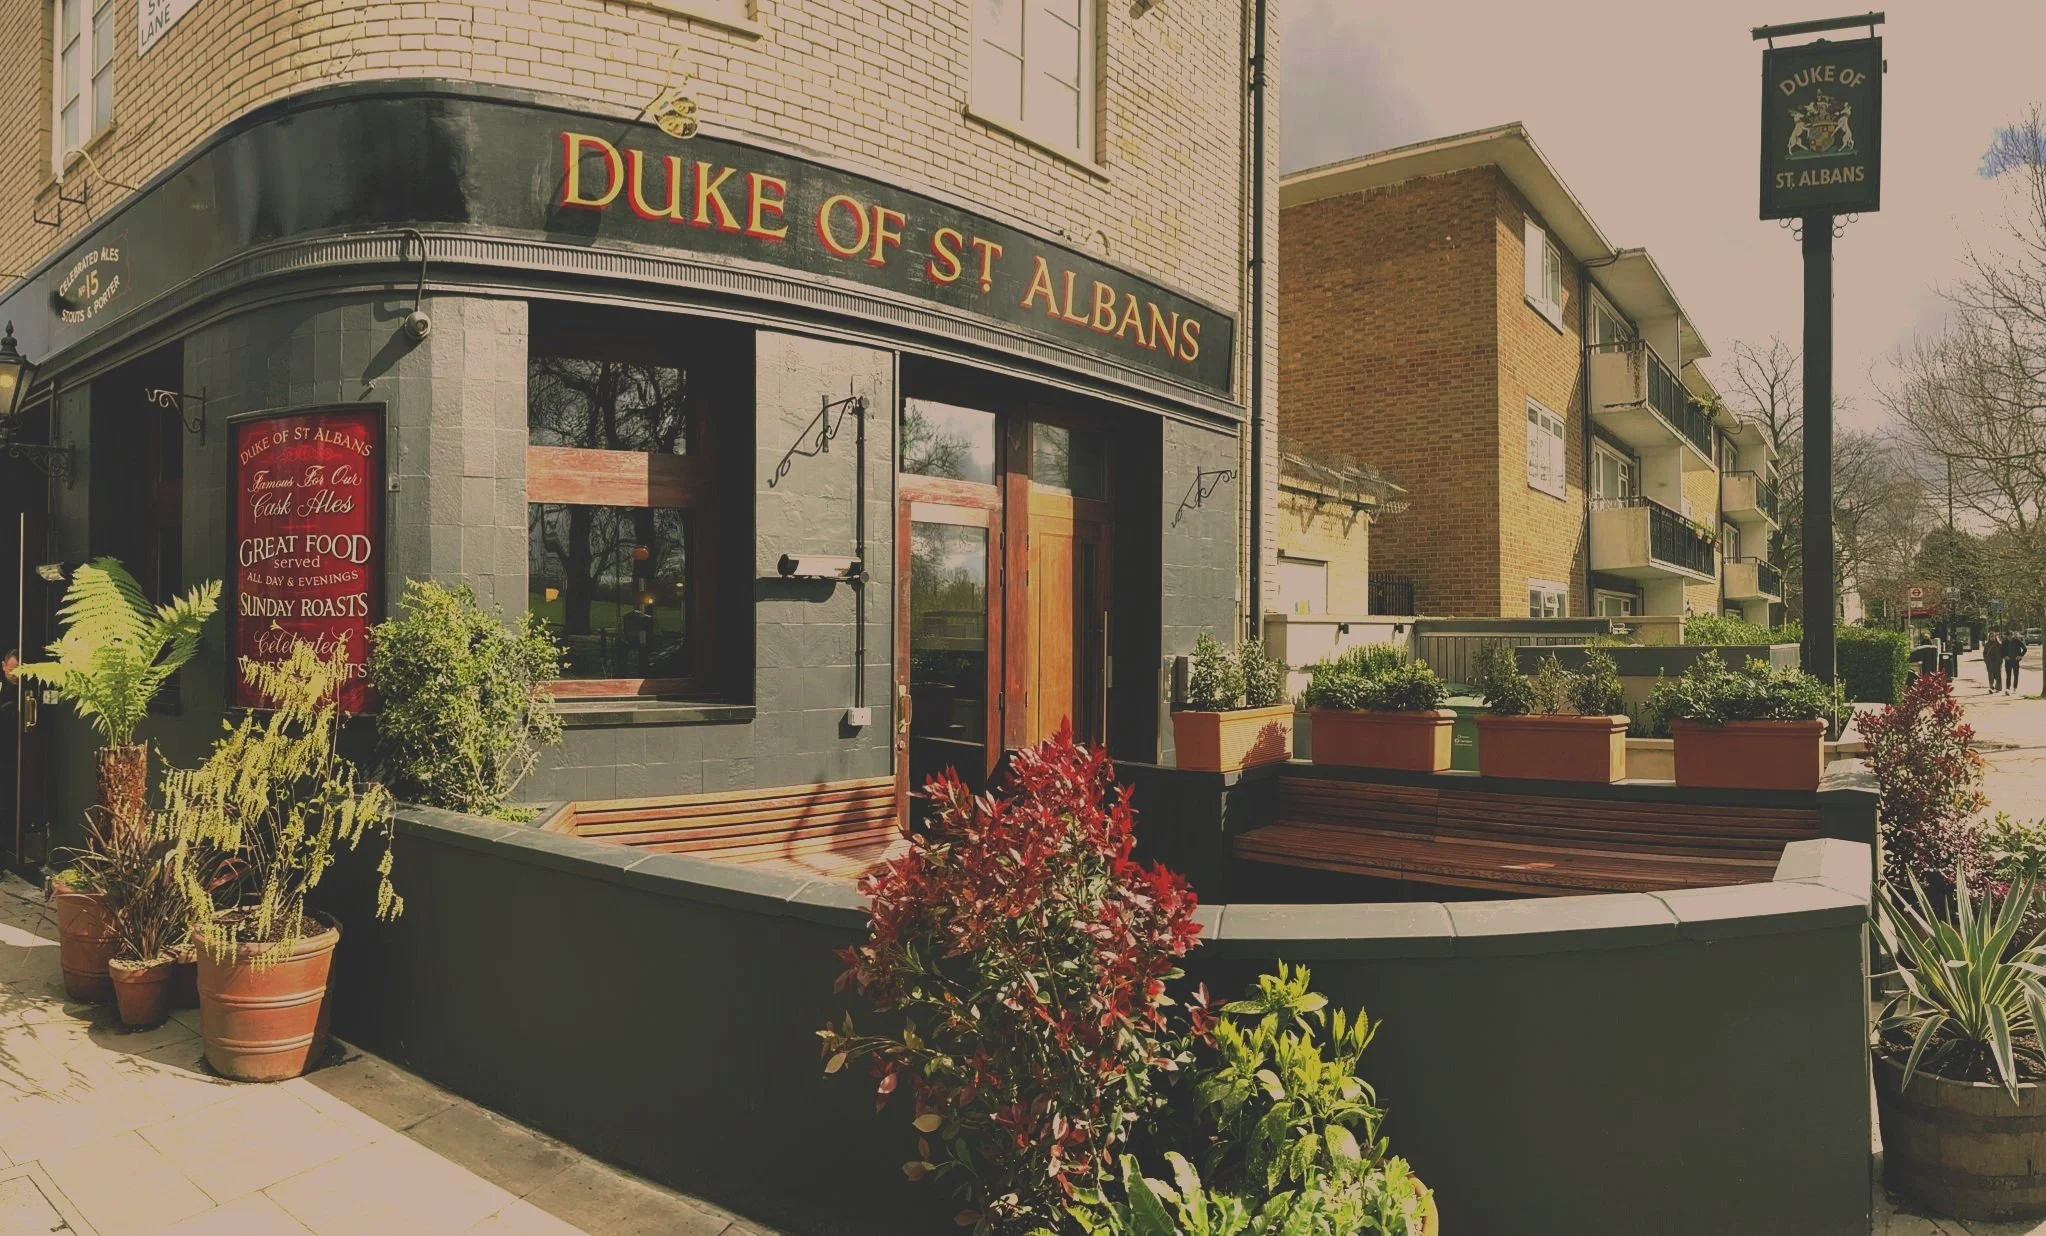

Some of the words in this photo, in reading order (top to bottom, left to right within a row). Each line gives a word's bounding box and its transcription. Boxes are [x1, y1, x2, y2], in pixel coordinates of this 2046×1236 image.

[141, 3, 170, 46] LANE
[1779, 65, 1836, 97] DUKE
[1839, 68, 1866, 88] OF
[1799, 165, 1865, 187] ALBANS
[560, 131, 789, 240] DUKE
[816, 194, 906, 268] OF
[1019, 255, 1201, 364] ALBANS
[59, 250, 99, 297] CELEBRATED
[101, 247, 119, 261] ALES
[86, 270, 99, 298] 15
[62, 309, 85, 323] STOUTS
[86, 305, 93, 318] &
[94, 274, 120, 313] PORTER
[240, 436, 271, 466] DUKE
[272, 429, 290, 445] OF
[313, 427, 373, 457] ALBANS
[247, 469, 295, 493] Famous
[296, 465, 326, 488] For
[331, 464, 362, 486] Our
[250, 492, 292, 524] Cask
[297, 489, 356, 518] Ales
[239, 535, 299, 567] GREAT
[306, 533, 372, 565] FOOD
[273, 555, 321, 569] served
[246, 572, 263, 584] ALL
[265, 576, 286, 587] DAY
[286, 577, 295, 587] &
[298, 569, 359, 587] EVENINGS
[240, 592, 296, 617] SUNDAY
[300, 592, 369, 617] ROASTS
[253, 626, 354, 657] Celeated
